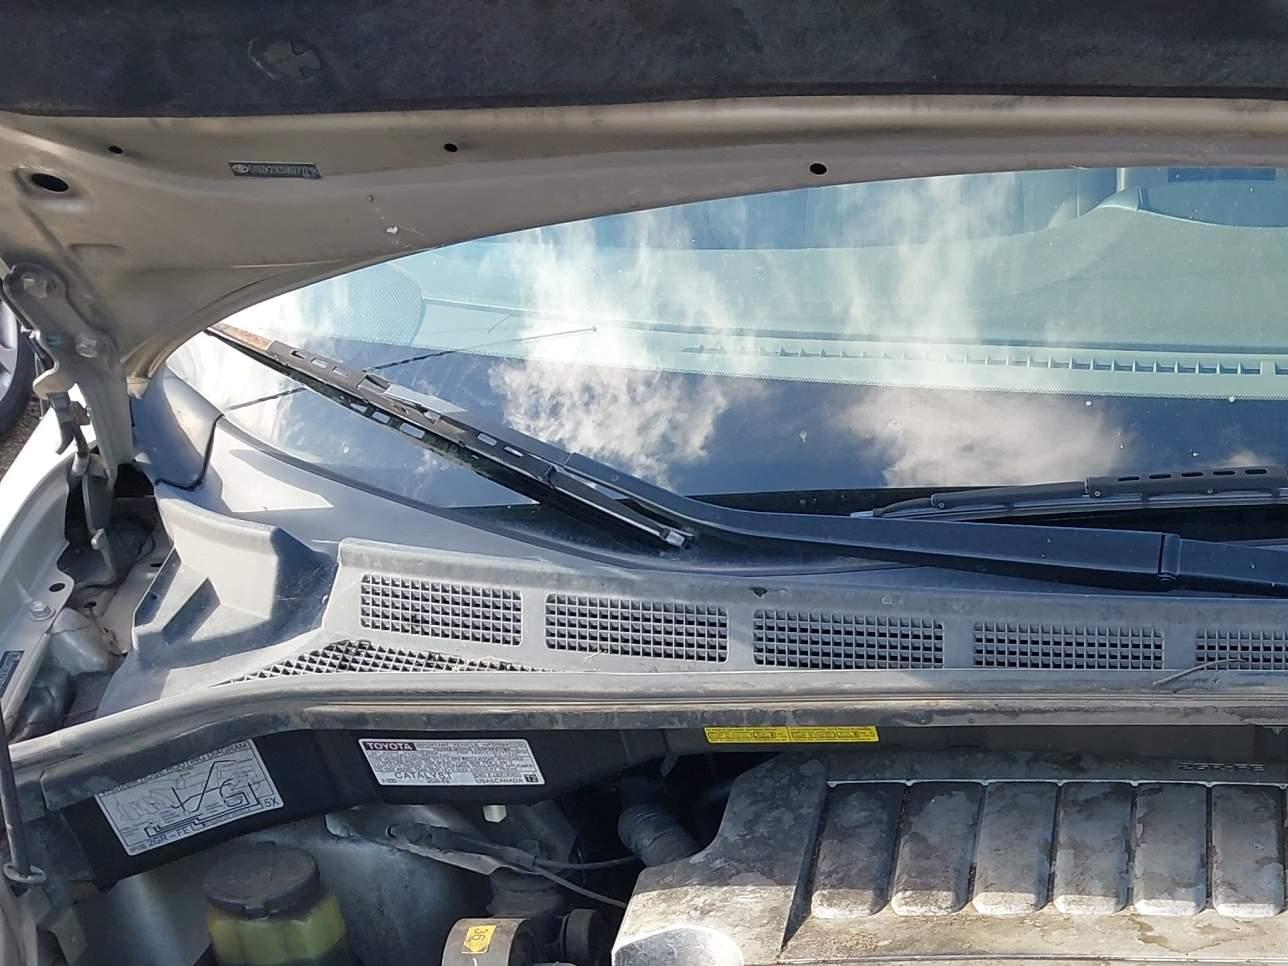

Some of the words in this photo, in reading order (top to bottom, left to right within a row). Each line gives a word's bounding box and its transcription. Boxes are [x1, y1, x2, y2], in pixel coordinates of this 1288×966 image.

[366, 742, 413, 751] TOYOTA
[394, 771, 452, 780] CATALYST
[264, 797, 279, 808] 5X
